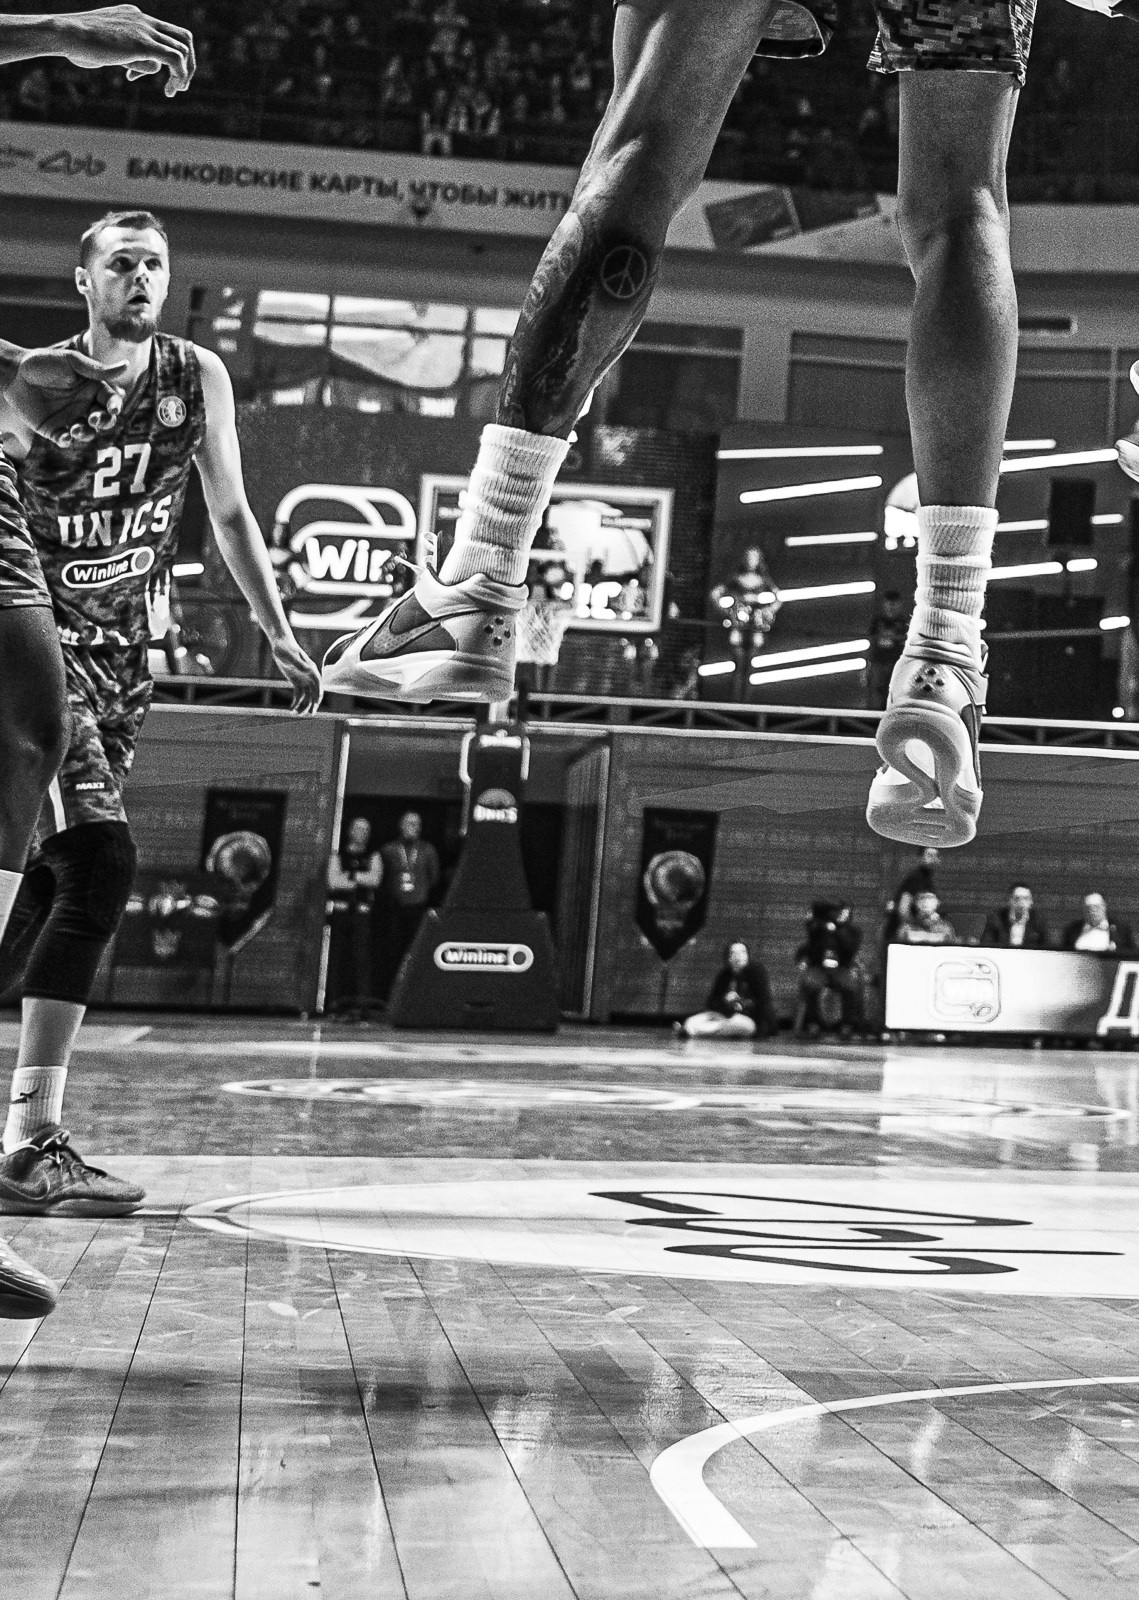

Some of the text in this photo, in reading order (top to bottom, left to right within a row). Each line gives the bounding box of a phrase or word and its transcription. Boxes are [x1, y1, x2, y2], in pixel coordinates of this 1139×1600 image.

[126, 156, 302, 192] БАНКОВСКИЕ
[408, 179, 498, 207] ЧТОБЫ
[93, 442, 152, 499] 27
[57, 494, 173, 549] UNICS
[73, 560, 129, 582] Winline
